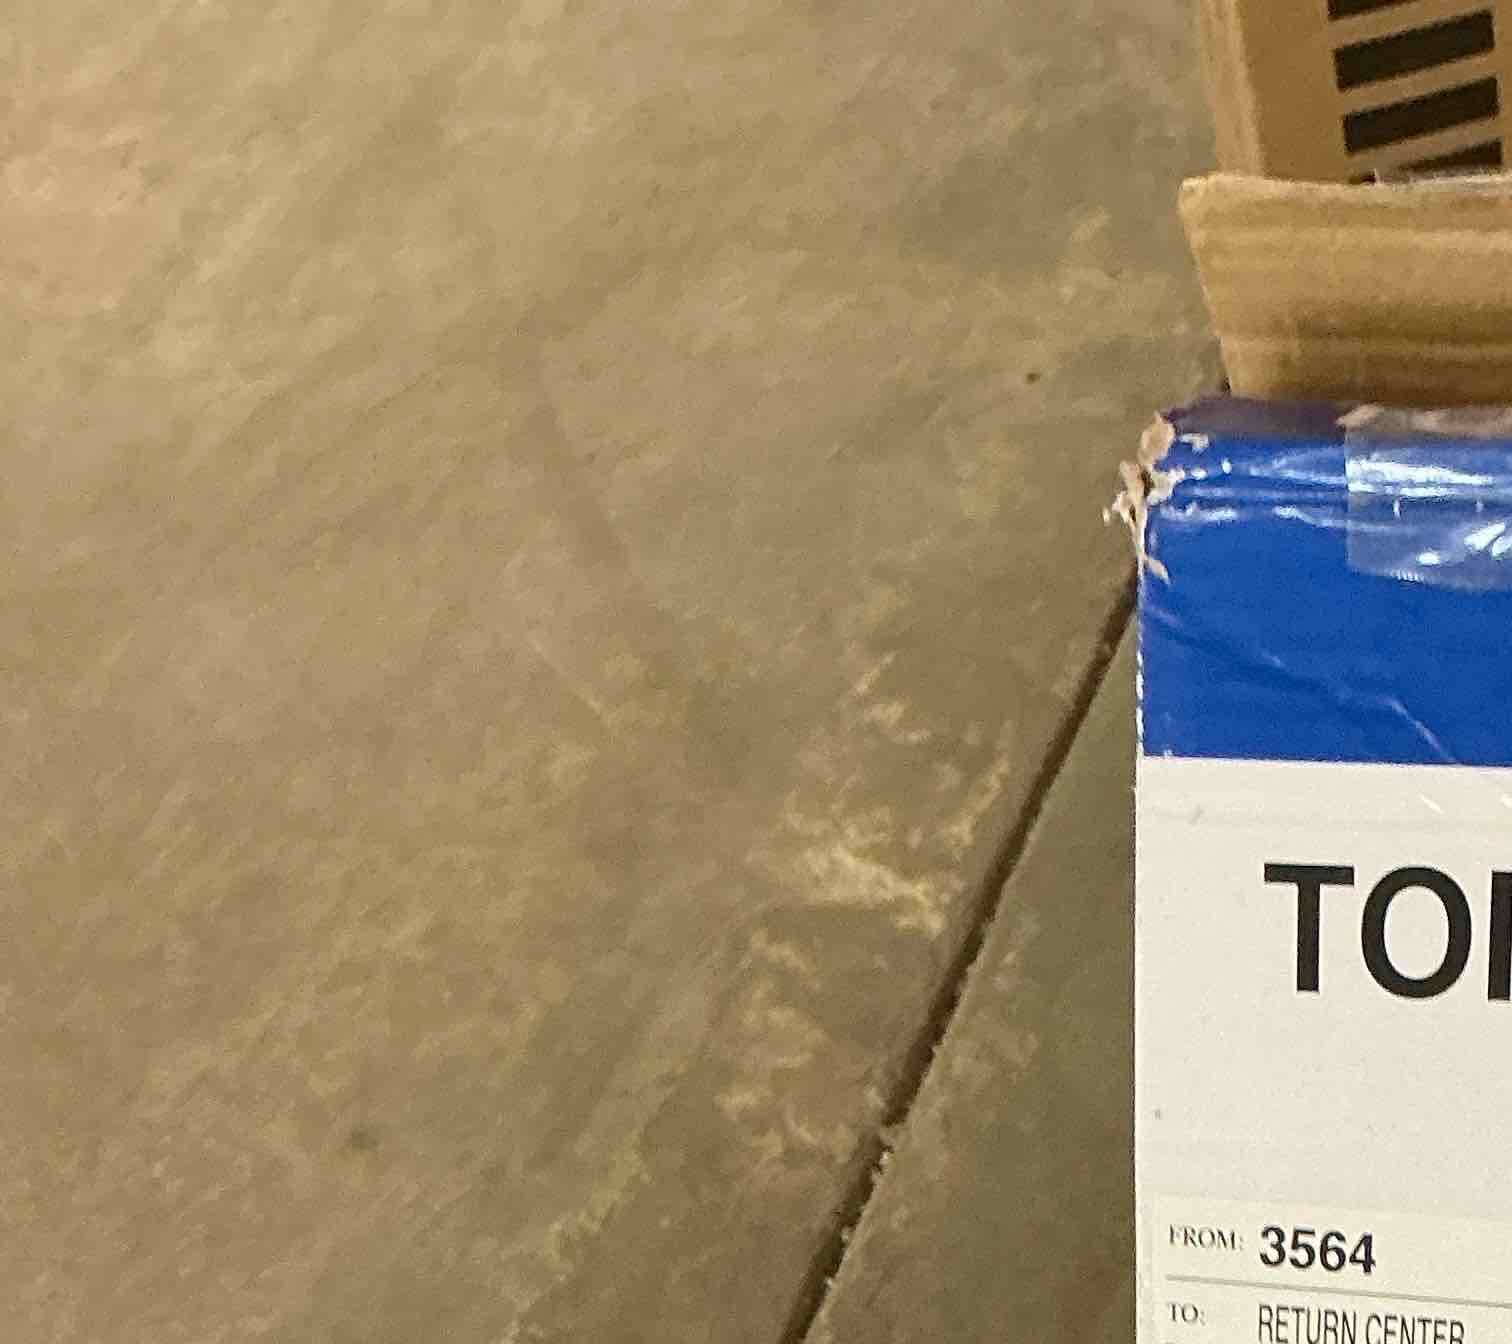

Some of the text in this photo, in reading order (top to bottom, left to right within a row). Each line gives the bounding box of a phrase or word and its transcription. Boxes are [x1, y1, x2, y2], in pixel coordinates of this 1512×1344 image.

[1168, 1224, 1377, 1275] FROM: 3564
[1168, 1302, 1206, 1326] TO:
